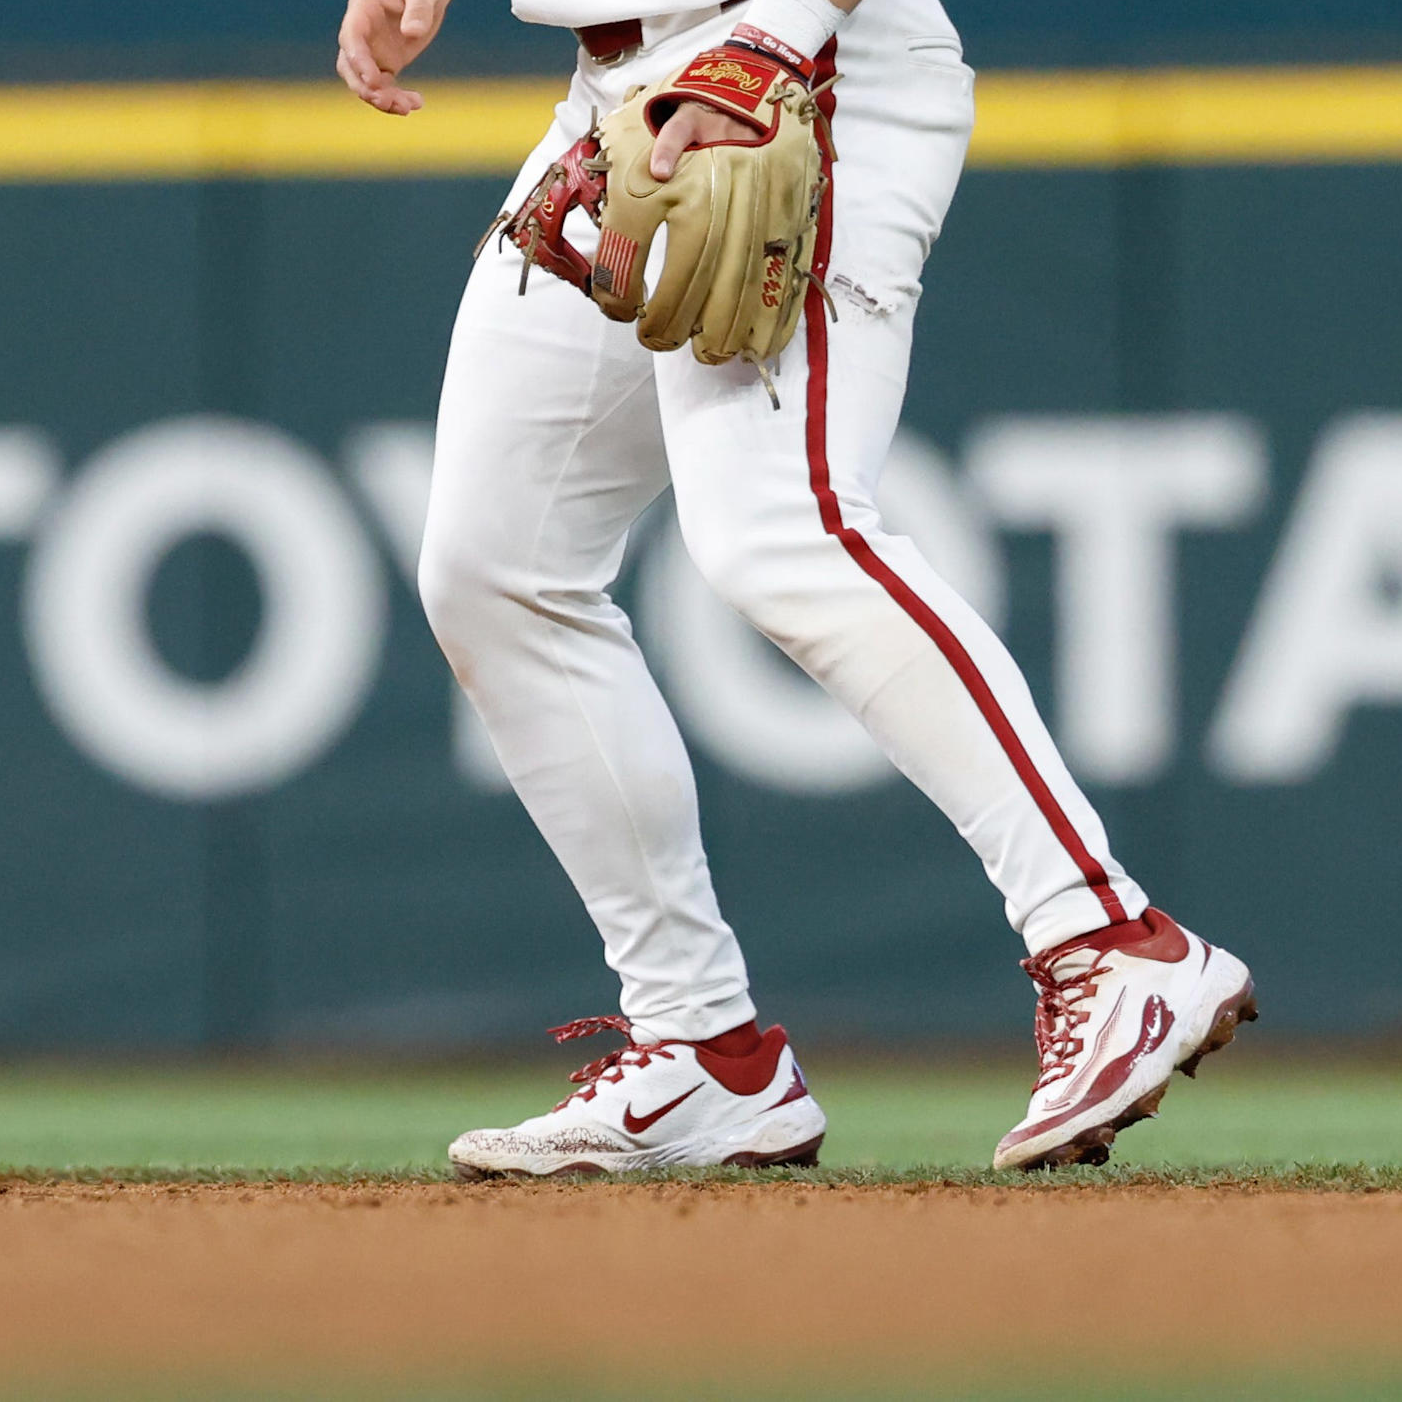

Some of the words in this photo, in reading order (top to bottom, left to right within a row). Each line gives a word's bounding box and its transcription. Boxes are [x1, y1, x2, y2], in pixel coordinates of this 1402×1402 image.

[763, 36, 777, 49] Go
[778, 44, 802, 65] Hogs
[689, 63, 762, 91] Rawlings
